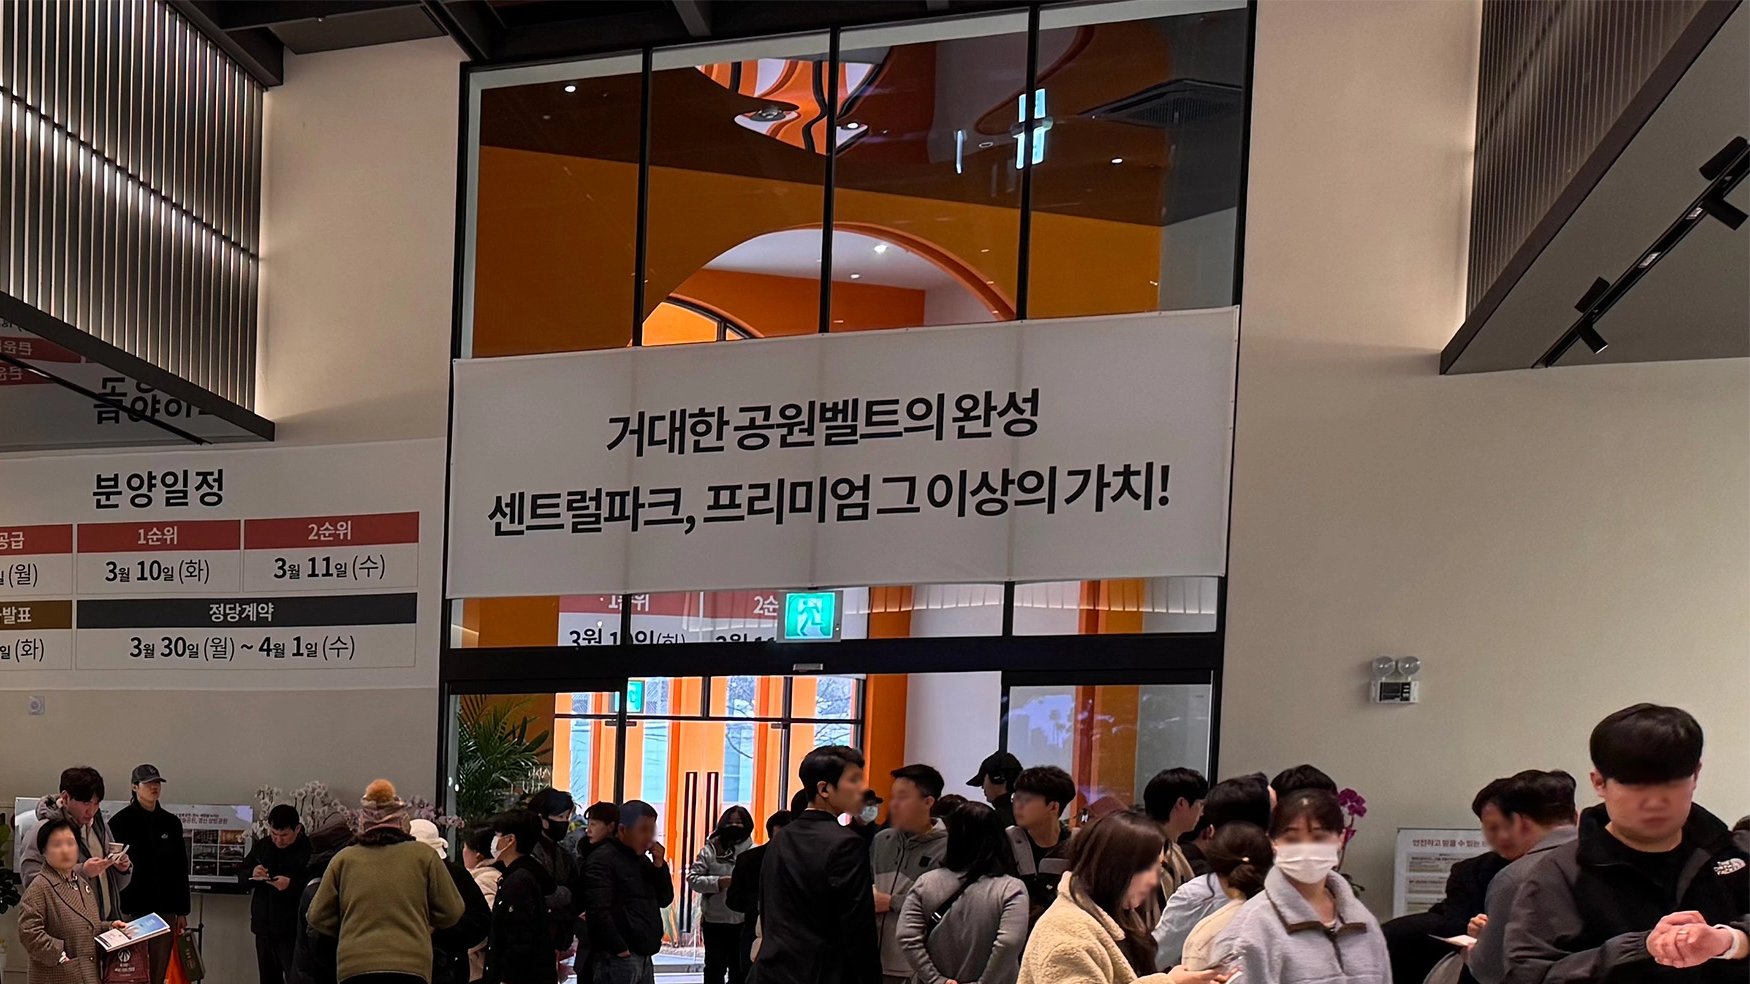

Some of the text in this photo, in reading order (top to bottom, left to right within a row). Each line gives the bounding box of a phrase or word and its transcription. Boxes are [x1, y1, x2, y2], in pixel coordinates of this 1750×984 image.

[606, 388, 1040, 458] 거대한 공원벨트의 완성
[92, 469, 225, 509] 분양일정
[488, 486, 696, 537] 센트럴파크,
[703, 474, 871, 528] 프리미엄
[1065, 462, 1171, 516] 가치!
[137, 526, 179, 546] 1순위
[307, 520, 352, 541] 2순위
[105, 561, 130, 582] 3월
[273, 558, 301, 580] 3월
[209, 602, 274, 622] 정당계약
[130, 637, 155, 658] 3월
[258, 635, 286, 657] 4월
